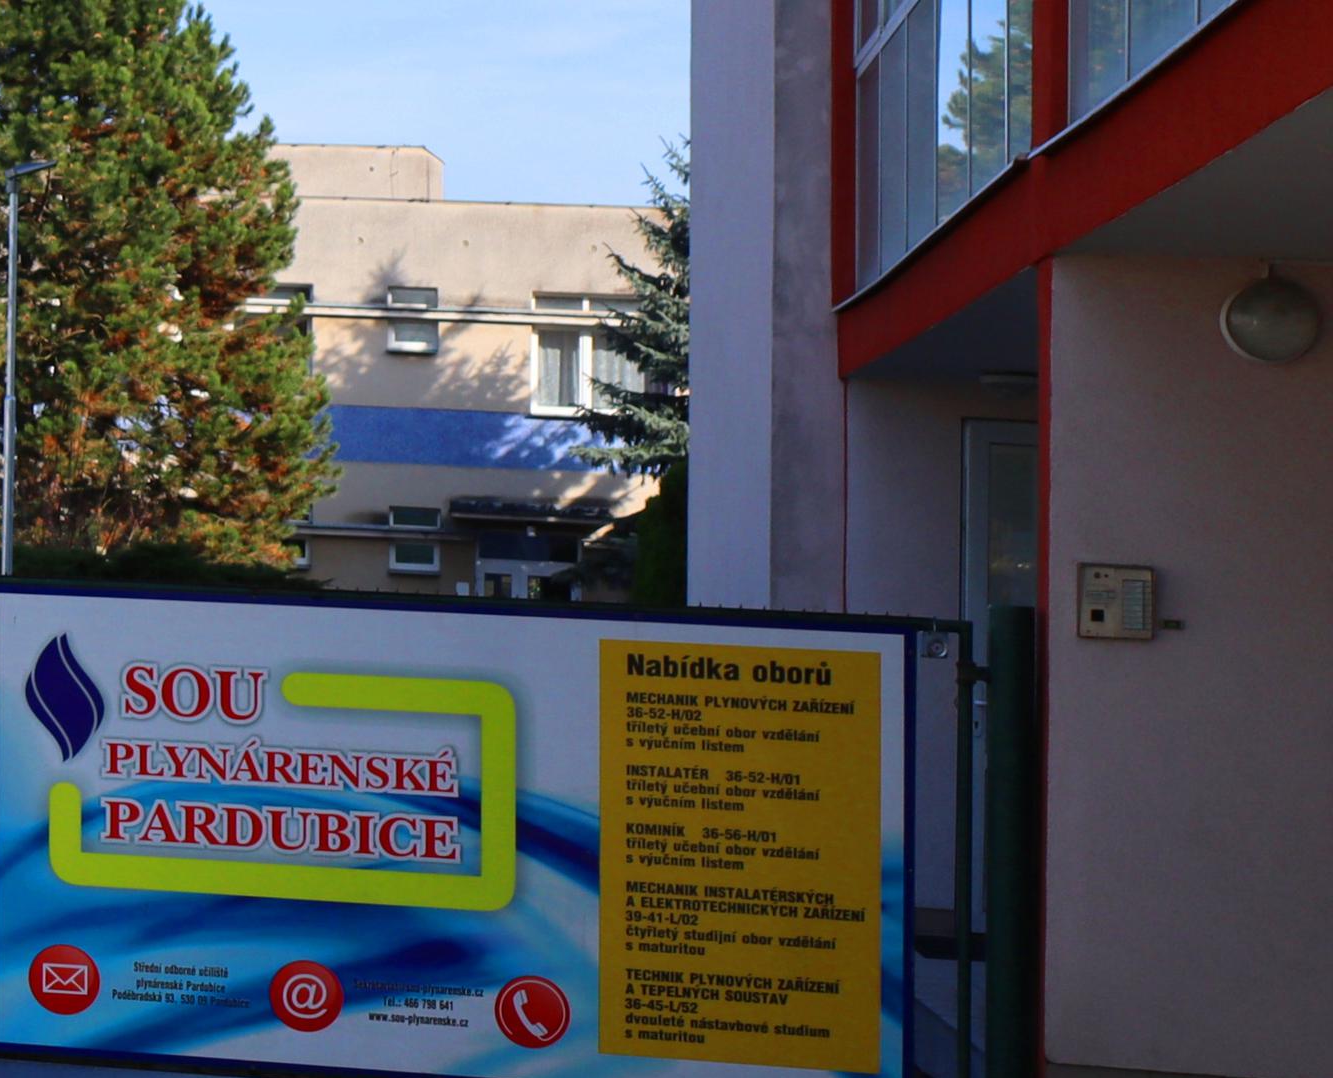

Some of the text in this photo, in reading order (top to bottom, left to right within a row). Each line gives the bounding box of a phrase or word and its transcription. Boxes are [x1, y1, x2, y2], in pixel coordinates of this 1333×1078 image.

[627, 654, 832, 685] Nabídka oborů
[124, 665, 266, 721] SOU
[627, 692, 854, 714] MECHANIK PLYNOVÝCH ZAŘÍZENÍ
[627, 708, 702, 721] 36-52-H/02
[627, 721, 819, 742] tříletý učební obor vzdělání
[627, 737, 744, 753] s výučním listem
[104, 741, 457, 794] PLYNÁRENSKÉ
[627, 764, 800, 785] INSTALATÉR 36-52-H/01
[627, 779, 819, 801] tříletý učební obor vzdělání
[627, 795, 744, 811] s výučním listem
[103, 799, 458, 861] PARDUBICE
[627, 822, 777, 842] KOMINÍK 36-56-H/01
[627, 838, 819, 860] tříletý učební obor vzdělání
[626, 854, 744, 870] s výučním listem
[627, 881, 834, 905] MECHANIK INSTALATÉRSKÝCH
[626, 897, 865, 922] A ELEKTROTECHNICKÝCH ZAŘÍZENÍ
[626, 911, 698, 925] 39-41-L/02
[626, 925, 836, 950] čtyřletý studijní obor vzdělání
[626, 943, 705, 956] s maturitou
[134, 961, 161, 973] Střední
[165, 965, 196, 976] odborné
[136, 978, 226, 993] plynárenské Pardubice
[626, 969, 840, 994] TECHNIK PLYNOVÝCH ZAŘÍZENÍ
[112, 989, 162, 1002] Poděbradská
[181, 994, 194, 1005] 530
[404, 998, 419, 1008] 466
[423, 999, 436, 1009] 798
[440, 1000, 453, 1010] 641
[626, 983, 788, 1005] A TEPELNÝCH SOUSTAV
[626, 998, 698, 1013] 36-45-L/52
[369, 1012, 468, 1027] www.sou-plynarenske.cz
[626, 1013, 830, 1038] dvouleté nástavbové studium
[626, 1030, 705, 1043] s maturitou
